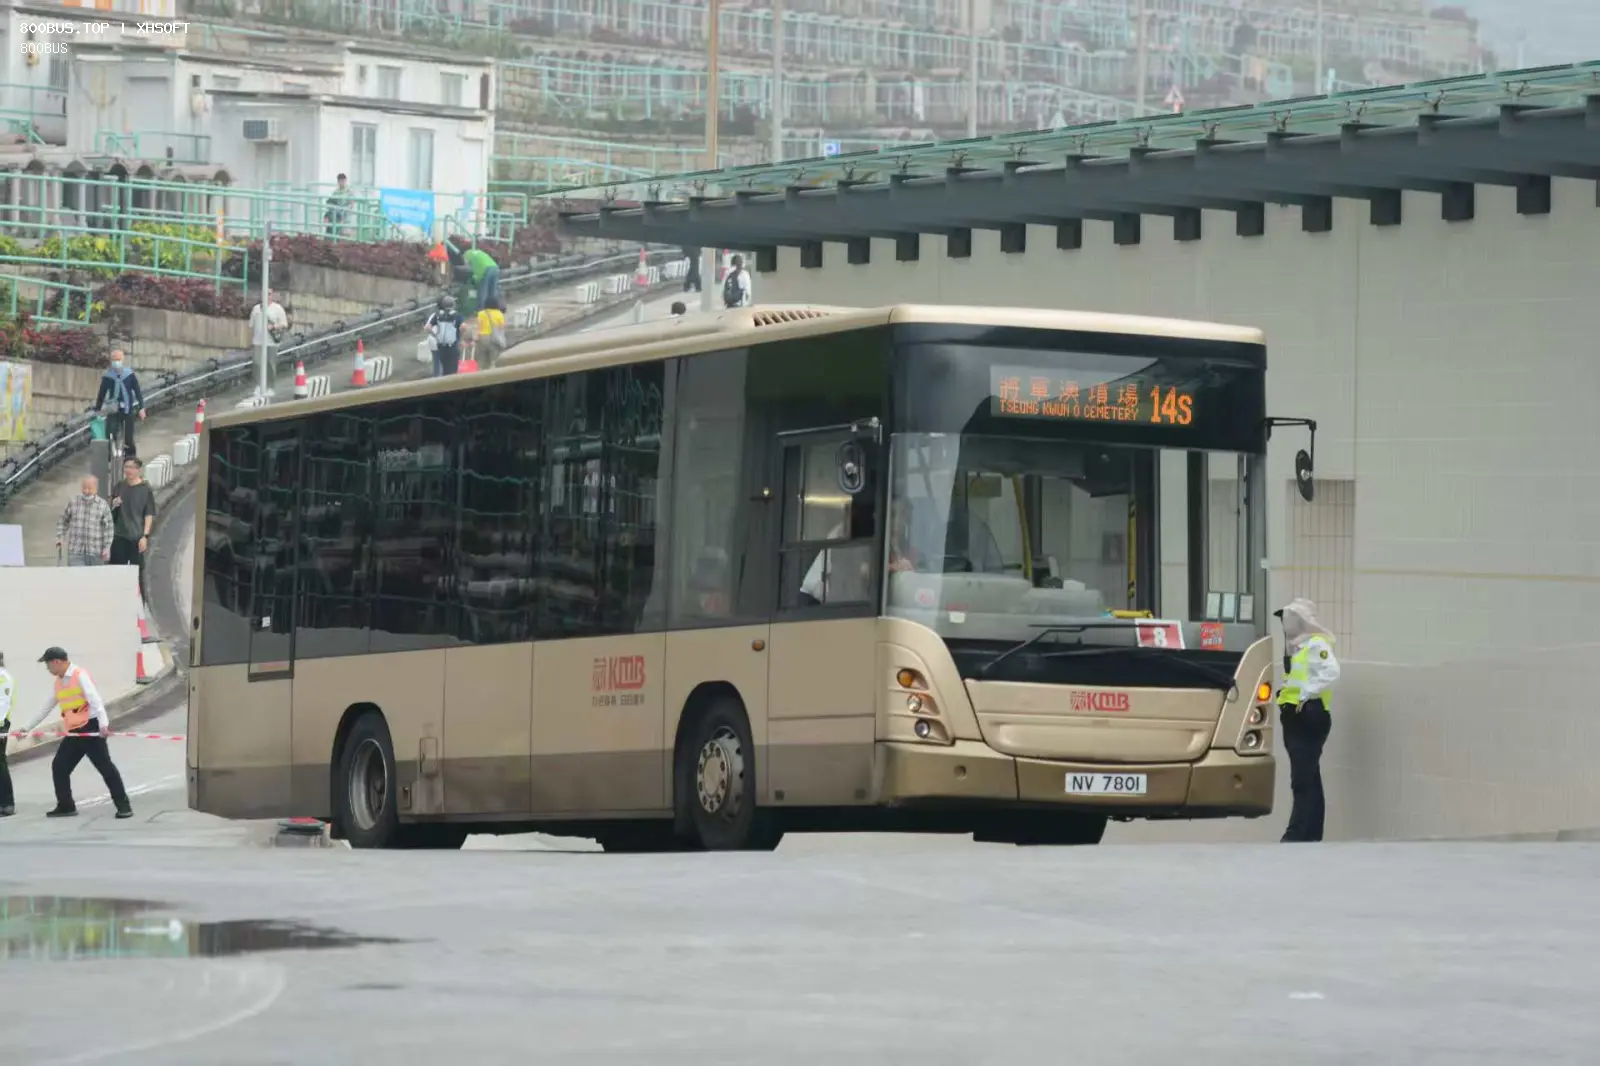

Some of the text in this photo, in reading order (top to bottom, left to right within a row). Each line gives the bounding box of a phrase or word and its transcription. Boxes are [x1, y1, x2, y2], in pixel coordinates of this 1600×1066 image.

[1000, 399, 1139, 421] TSEUNG KWUN O CEMETERY
[1150, 385, 1193, 425] 14S
[1153, 627, 1168, 647] 8
[1086, 692, 1129, 712] KMB
[1072, 775, 1140, 791] NV 7801
